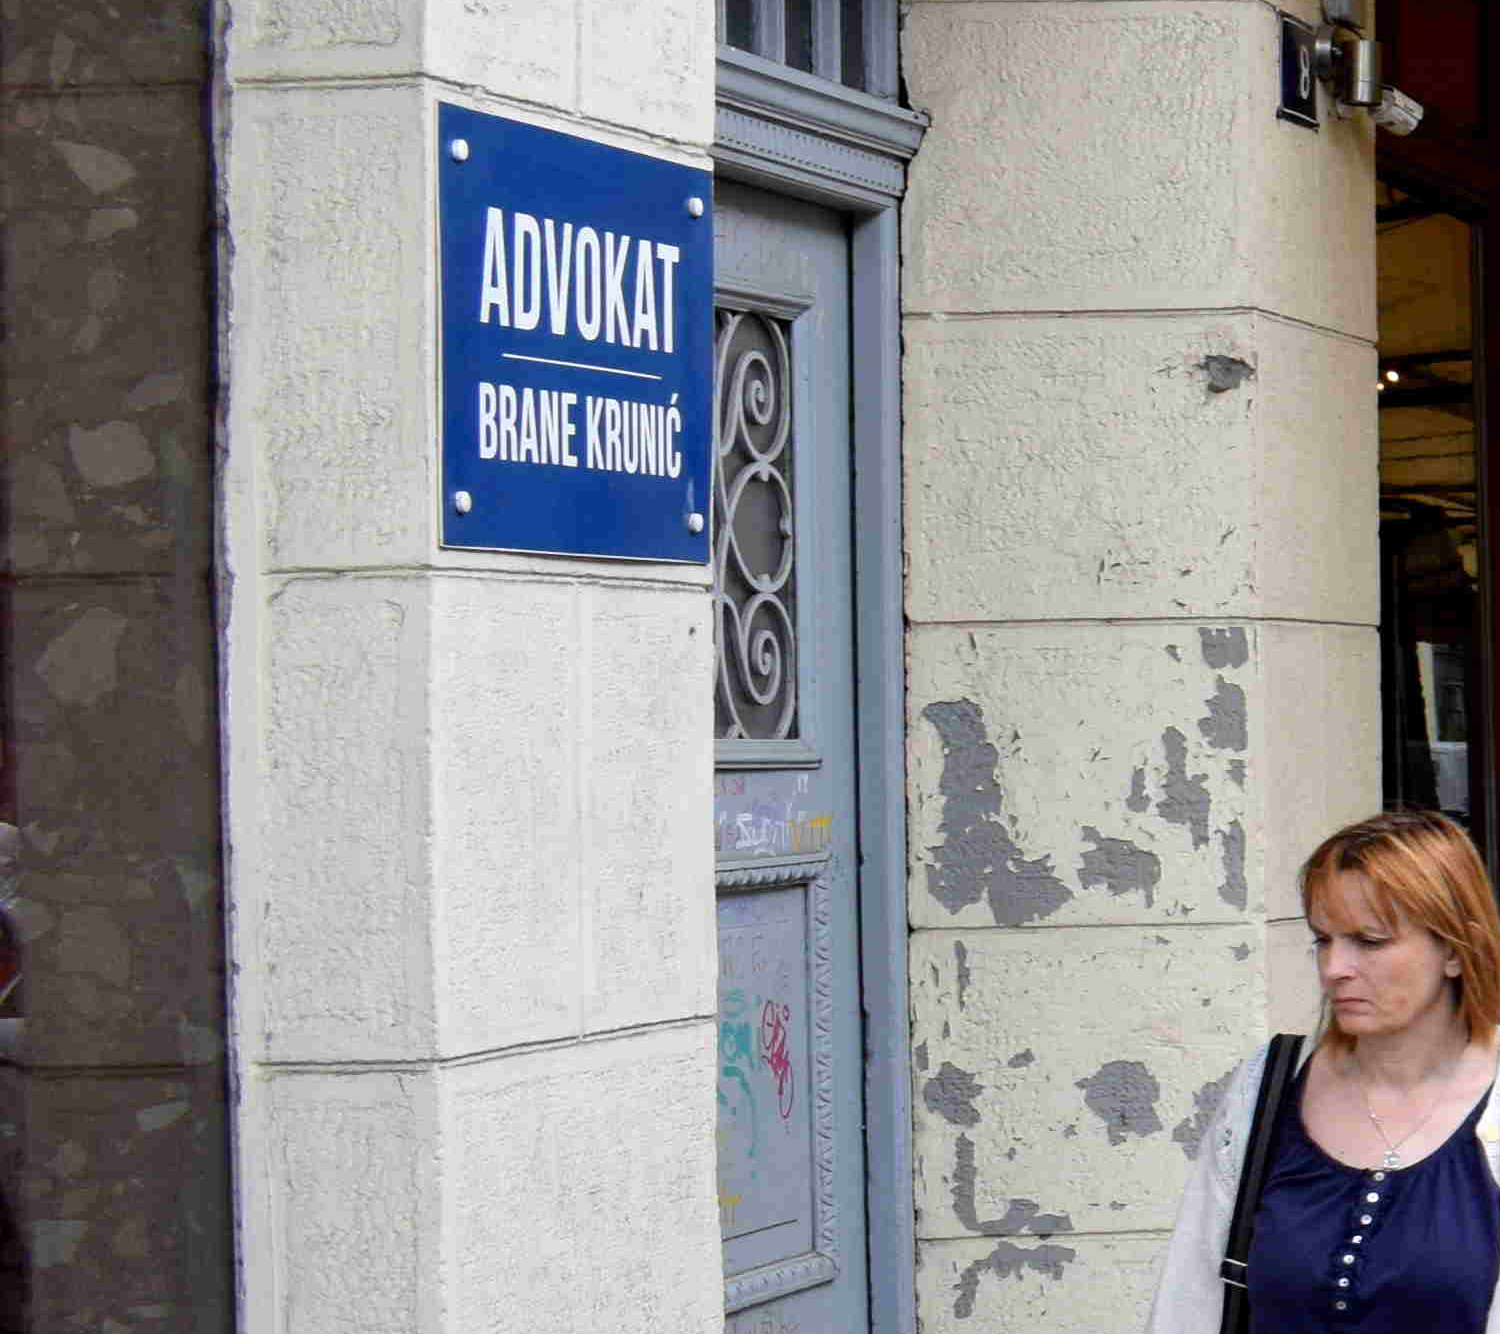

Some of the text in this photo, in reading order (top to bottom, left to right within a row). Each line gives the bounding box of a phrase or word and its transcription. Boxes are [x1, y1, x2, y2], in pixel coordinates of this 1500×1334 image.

[479, 206, 680, 354] ADVOKAT
[479, 381, 681, 479] BRANE KRUNIĆ
